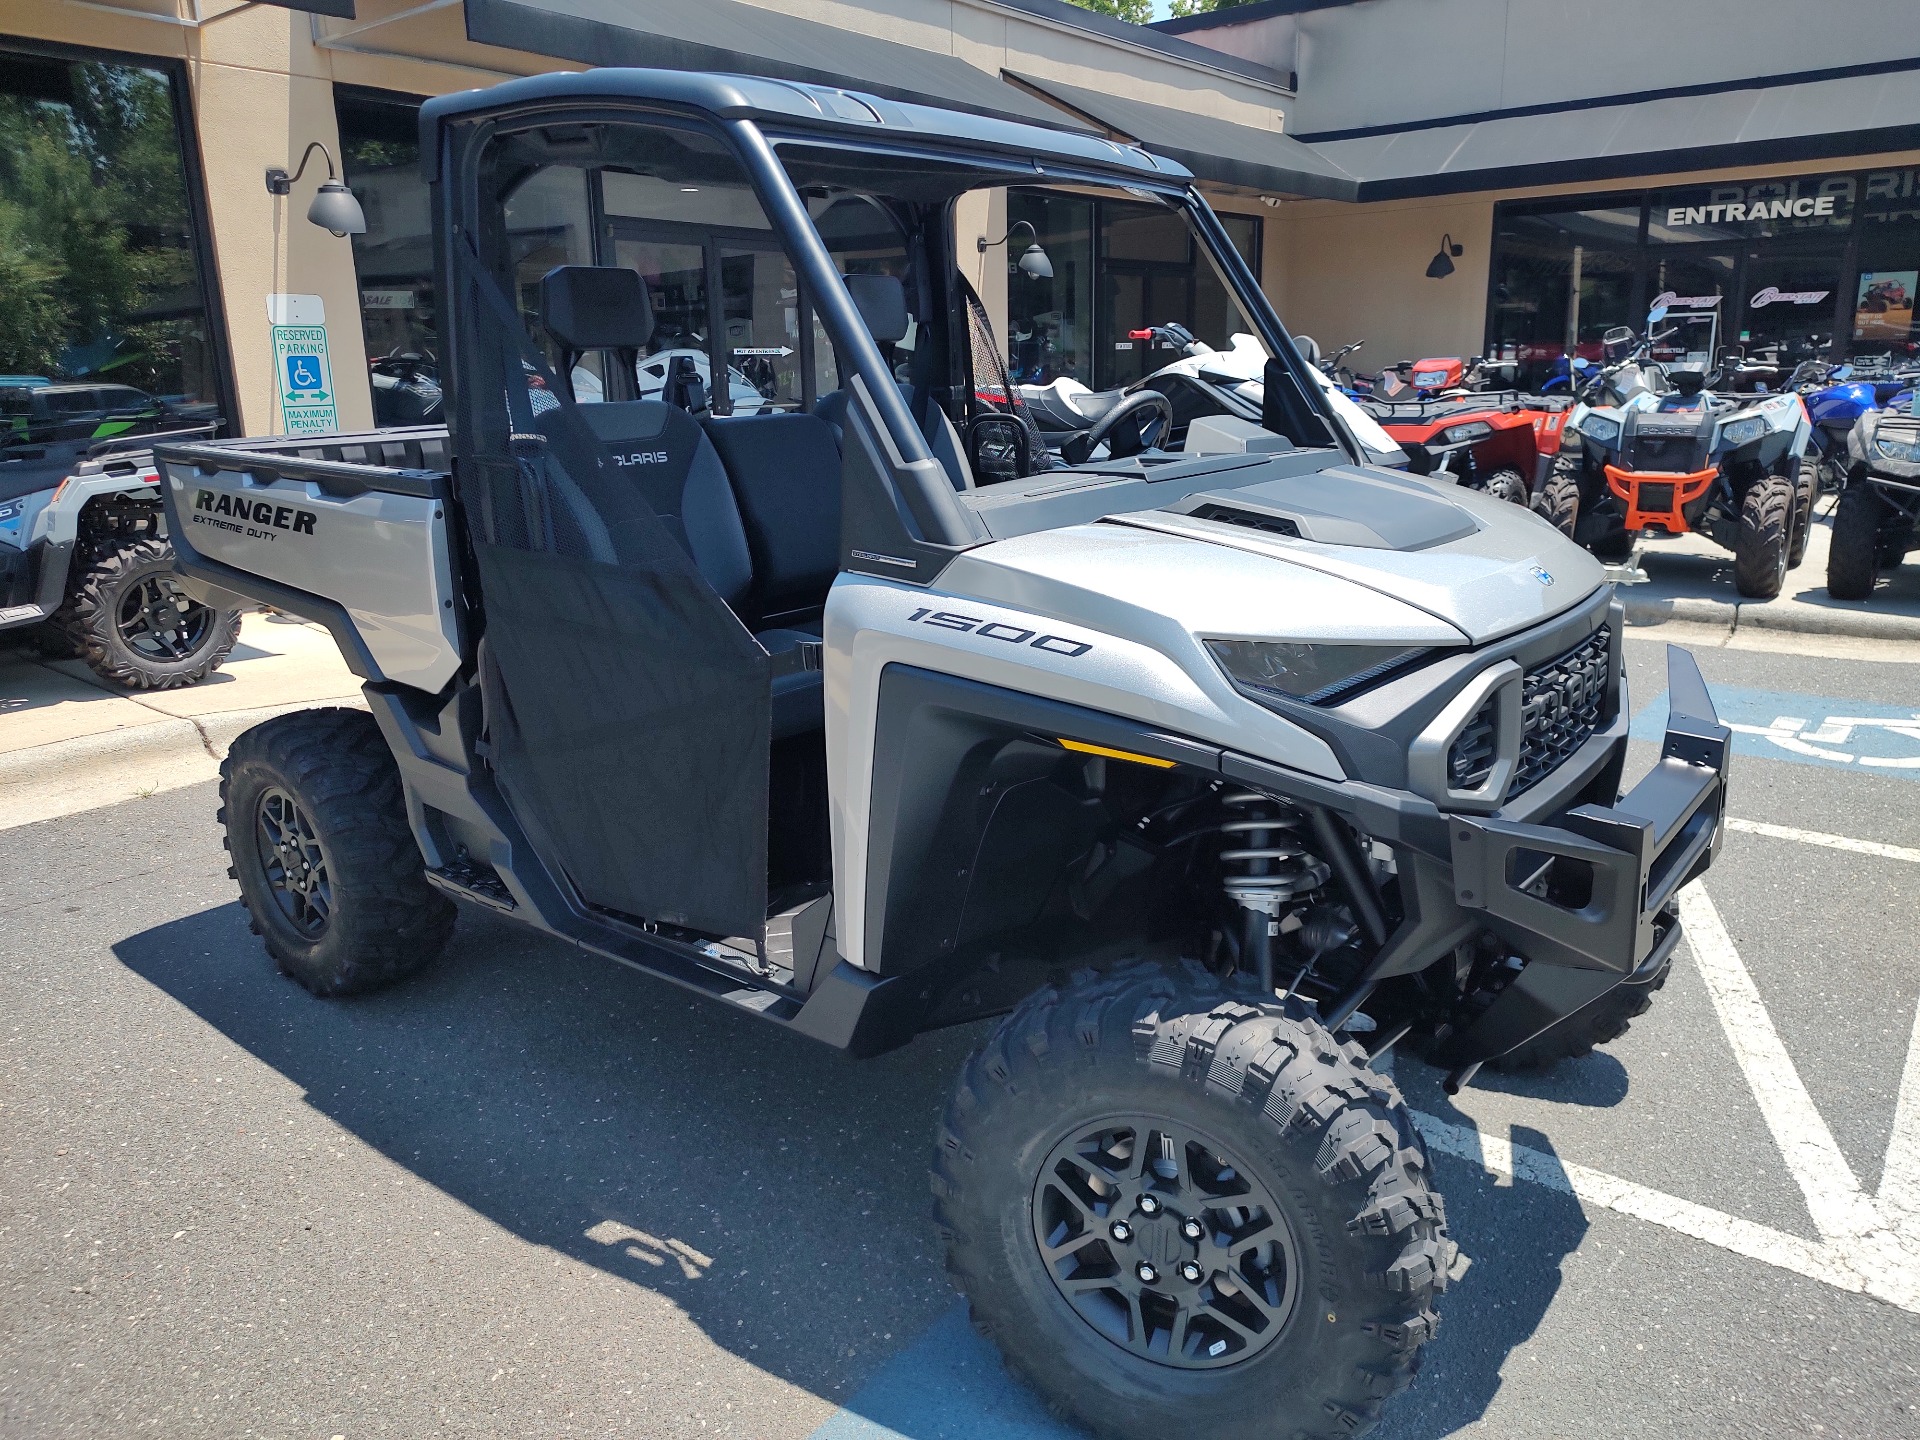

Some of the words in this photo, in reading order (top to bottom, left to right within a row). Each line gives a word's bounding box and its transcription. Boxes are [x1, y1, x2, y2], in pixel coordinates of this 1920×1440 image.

[1667, 197, 1834, 226] ENTRANCE
[365, 296, 393, 305] SALE
[277, 330, 323, 340] RESERVED
[279, 344, 324, 354] PARKING
[288, 410, 333, 418] MAXIMUM
[291, 420, 331, 428] PENALTY
[1640, 427, 1694, 435] POLARIS
[612, 451, 668, 466] OLARIS
[196, 489, 317, 535] RANGER
[193, 515, 243, 533] EXTREME
[247, 528, 277, 541] DUTY
[907, 607, 1094, 657] 1500
[1521, 651, 1609, 734] POLARIS
